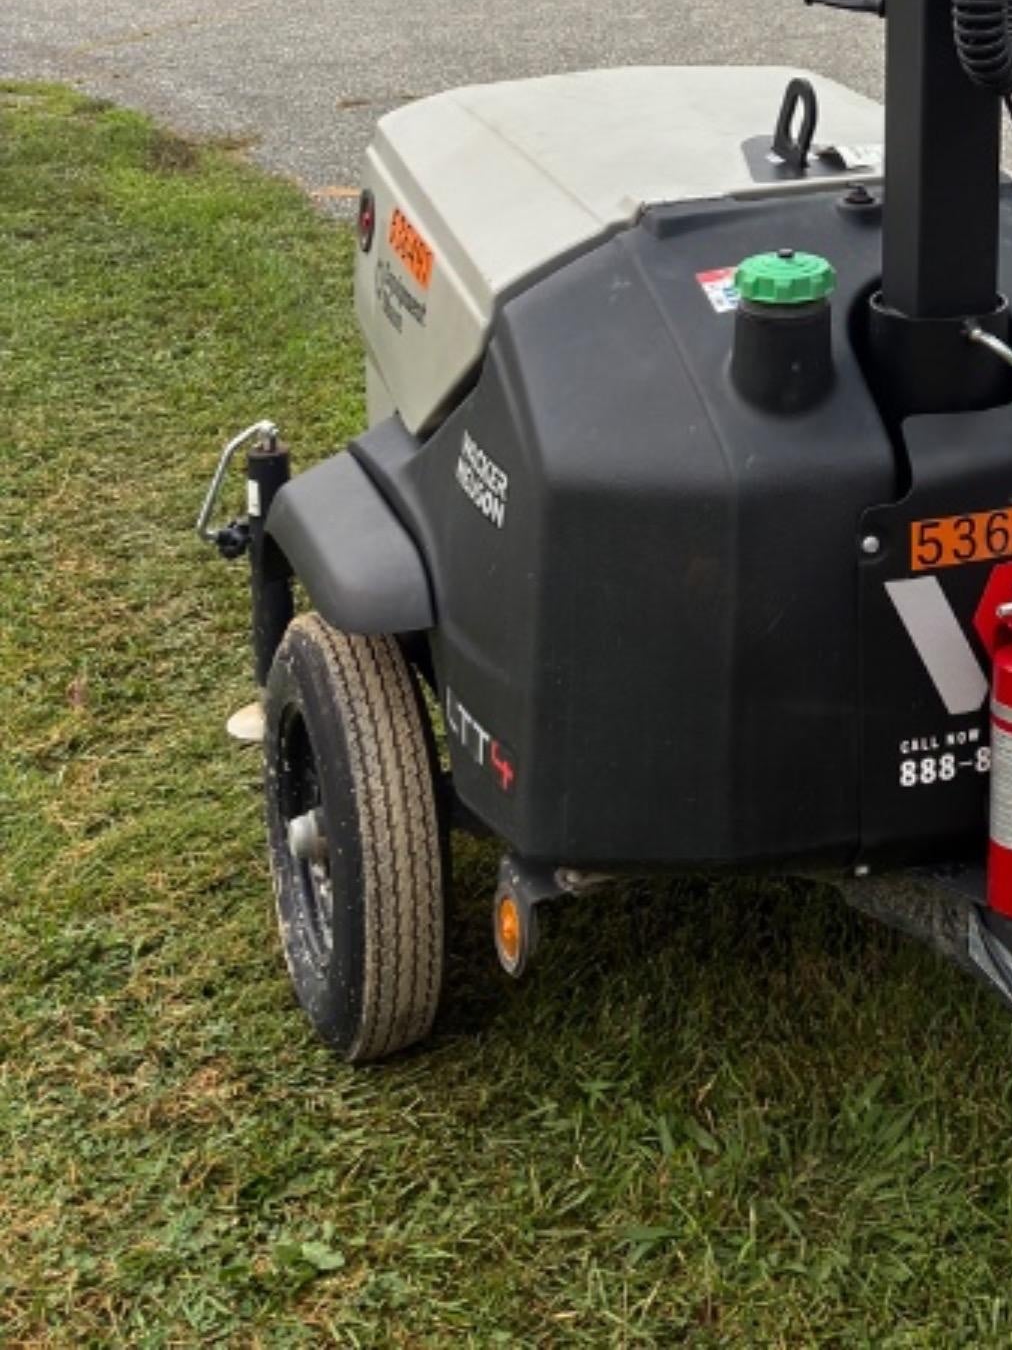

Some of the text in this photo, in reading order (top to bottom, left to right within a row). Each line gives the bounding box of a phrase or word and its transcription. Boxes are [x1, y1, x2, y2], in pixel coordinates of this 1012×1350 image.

[899, 728, 980, 754] CALL NOW
[899, 746, 992, 787] 888-8
